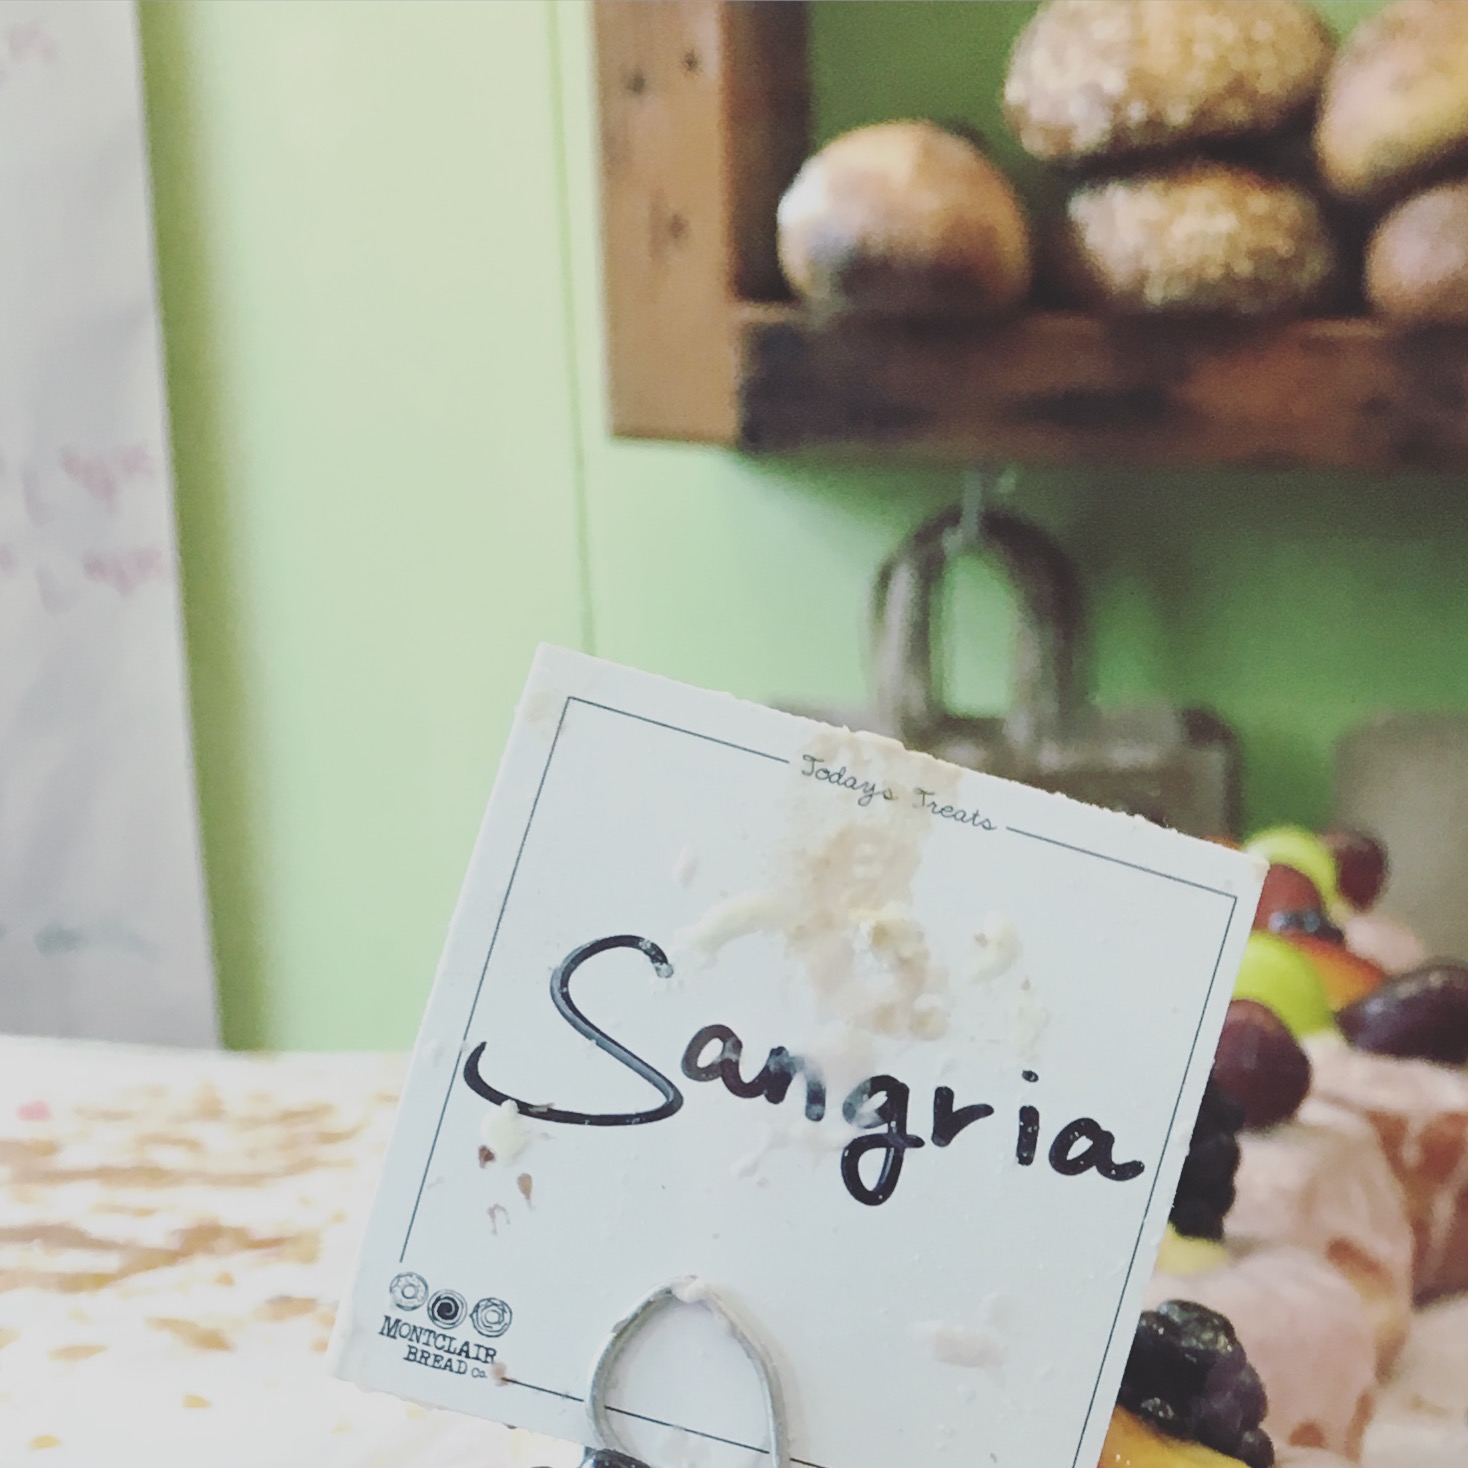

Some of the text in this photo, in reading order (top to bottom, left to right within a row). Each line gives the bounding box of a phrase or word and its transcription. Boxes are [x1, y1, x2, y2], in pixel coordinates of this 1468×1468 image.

[912, 787, 998, 831] Treats
[462, 934, 1146, 1206] Sangria
[378, 1315, 497, 1363] MONTCLAIR
[403, 1345, 468, 1375] BREAD
